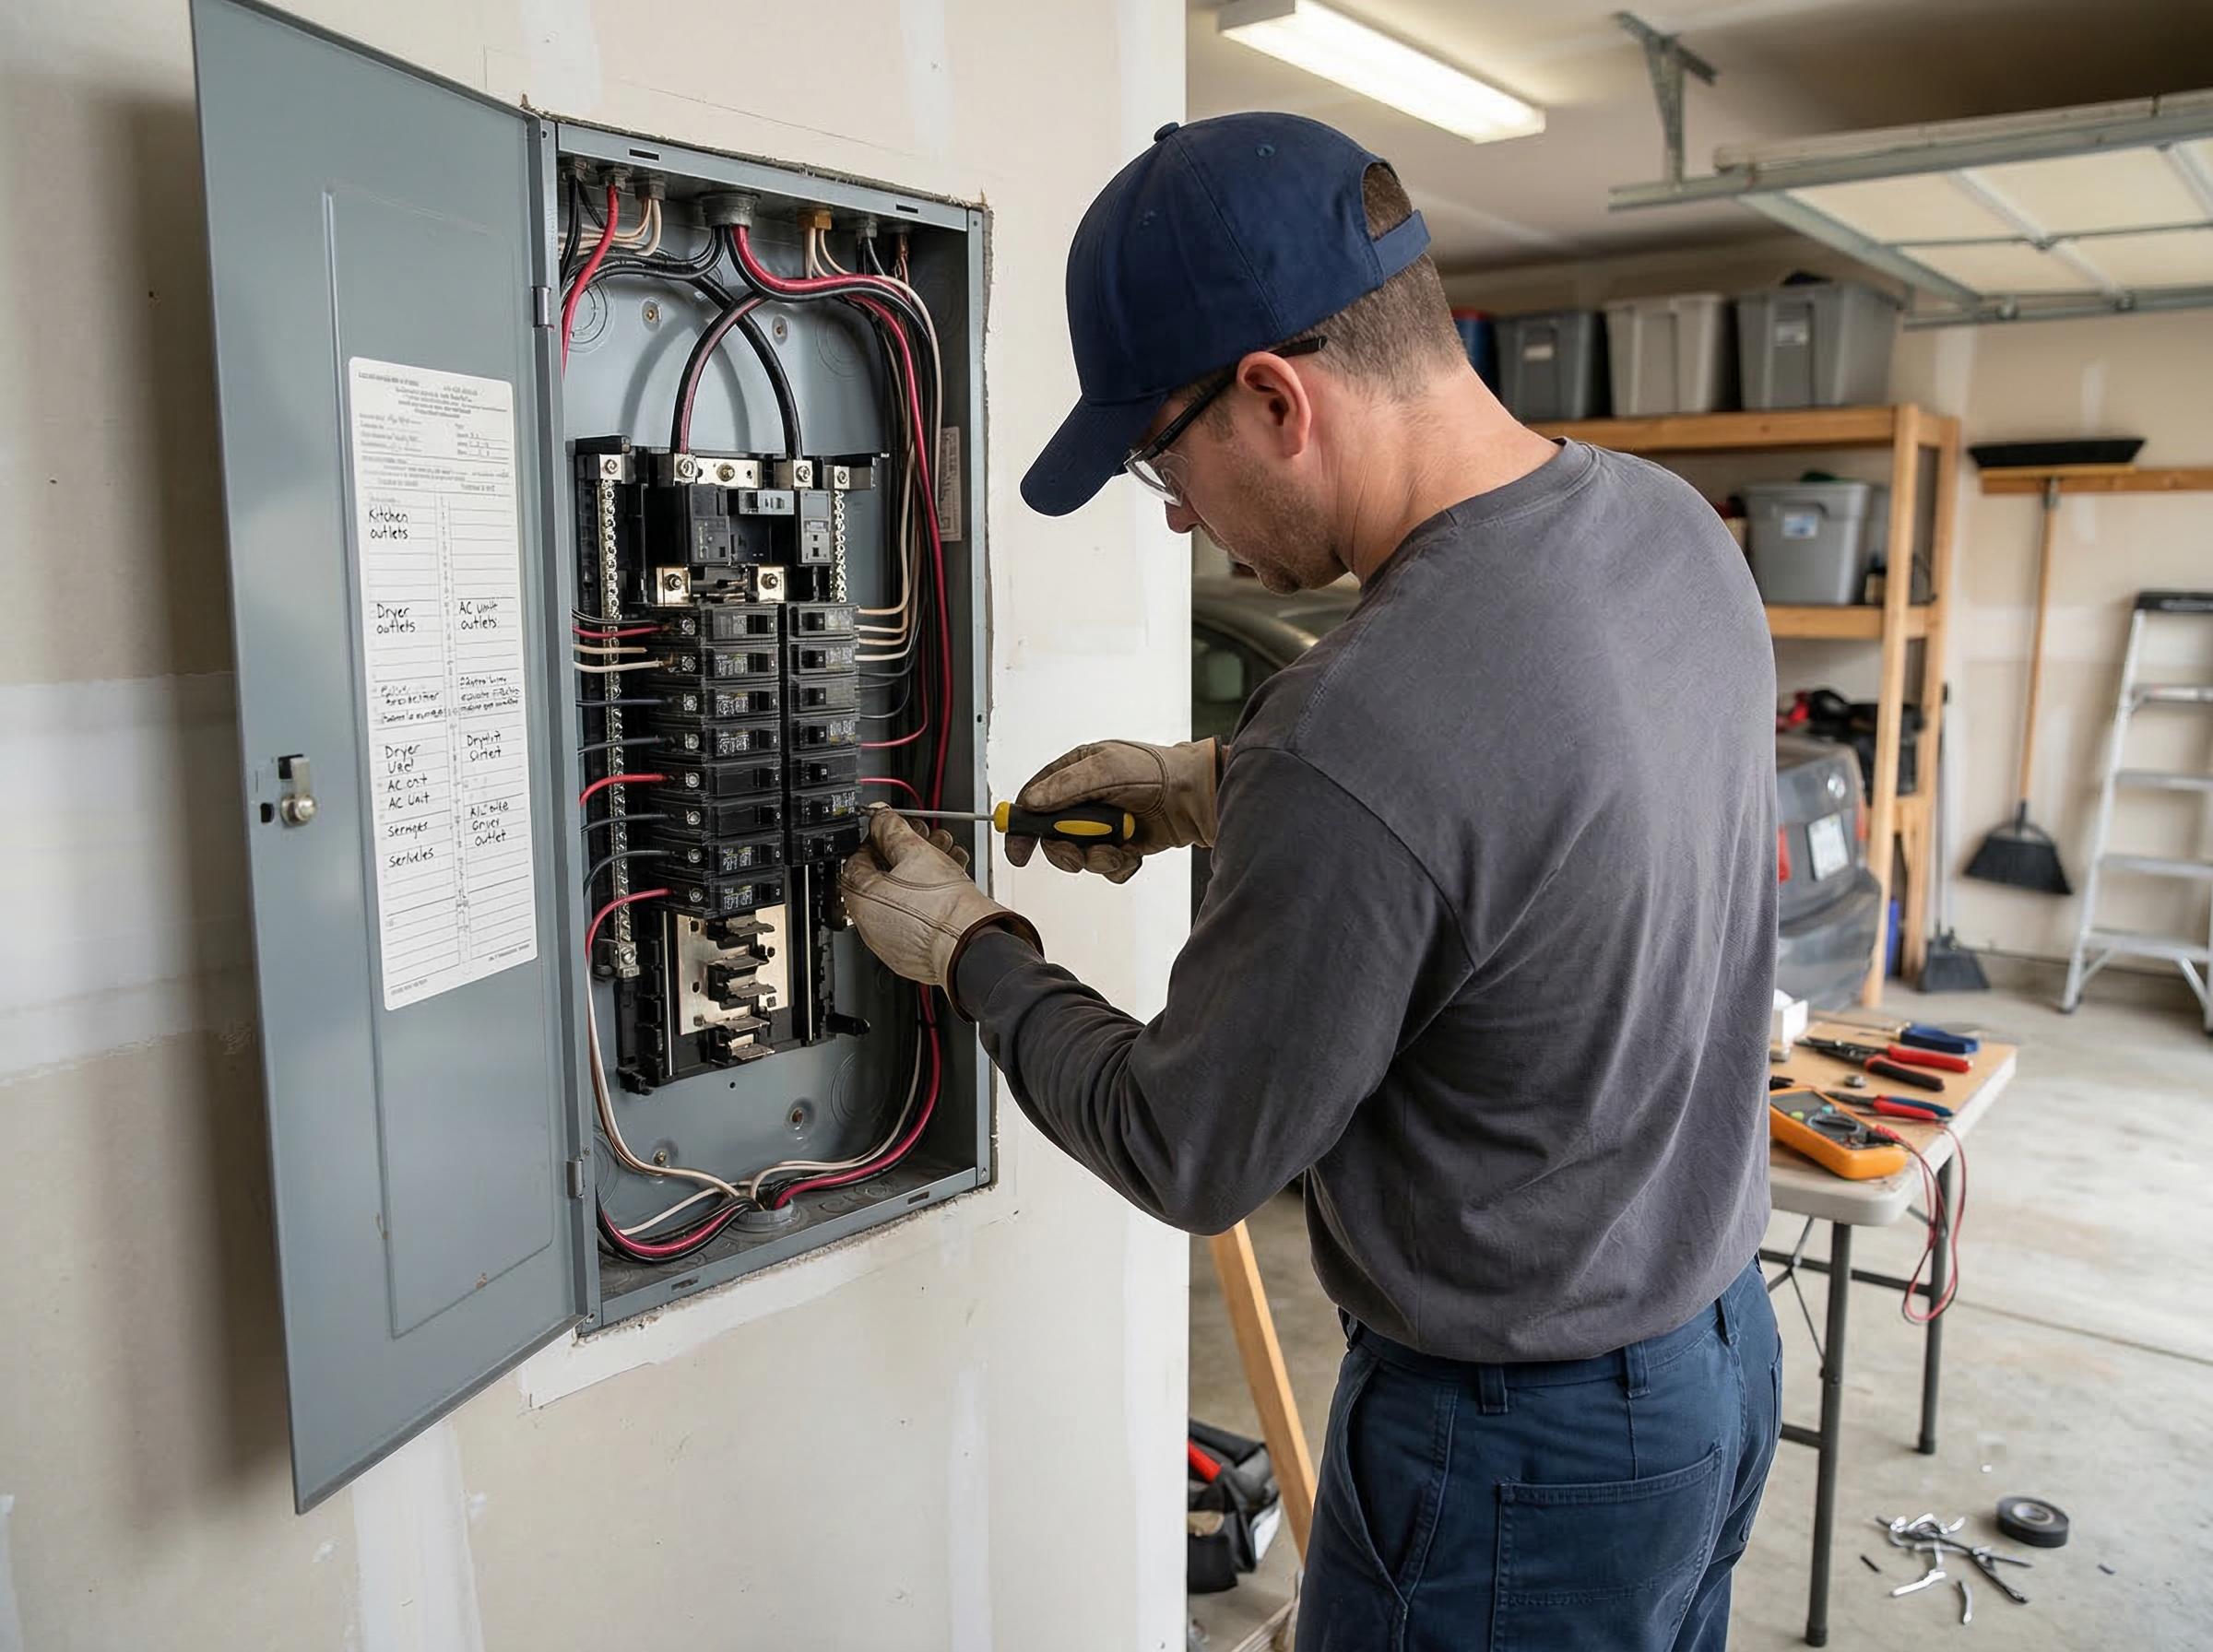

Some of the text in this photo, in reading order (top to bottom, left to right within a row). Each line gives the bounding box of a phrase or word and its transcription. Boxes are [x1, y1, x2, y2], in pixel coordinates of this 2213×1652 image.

[369, 506, 408, 524] Kitchen
[370, 525, 408, 539] outlets
[376, 603, 410, 622] Dryer
[459, 601, 473, 615] AC
[385, 745, 421, 762] Dryer
[388, 796, 404, 809] AC
